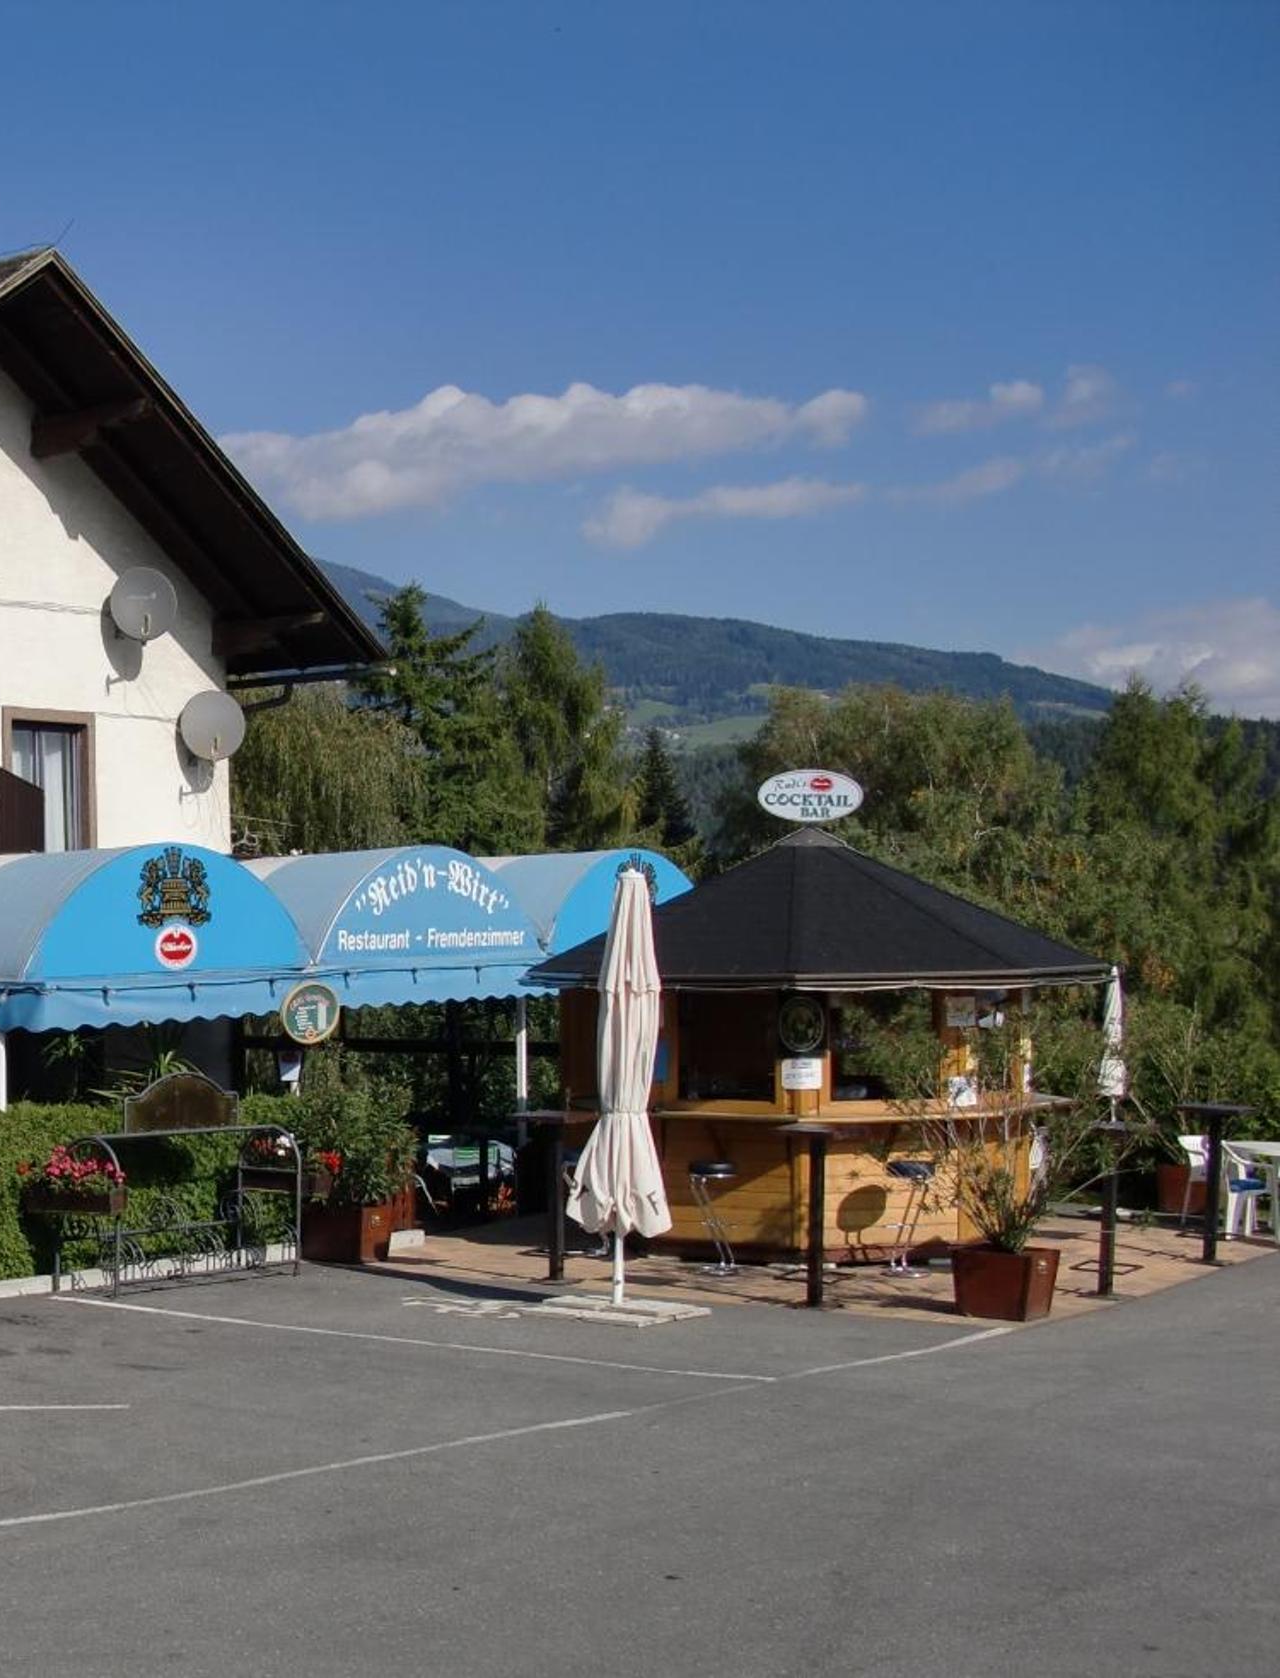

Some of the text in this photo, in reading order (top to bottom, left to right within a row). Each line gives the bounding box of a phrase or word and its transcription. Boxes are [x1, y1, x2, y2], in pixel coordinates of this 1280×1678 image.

[764, 793, 854, 808] COCKTAIL
[800, 806, 831, 818] BAR
[338, 929, 410, 951] Restaurant
[427, 926, 525, 948] Fremdenzimmer
